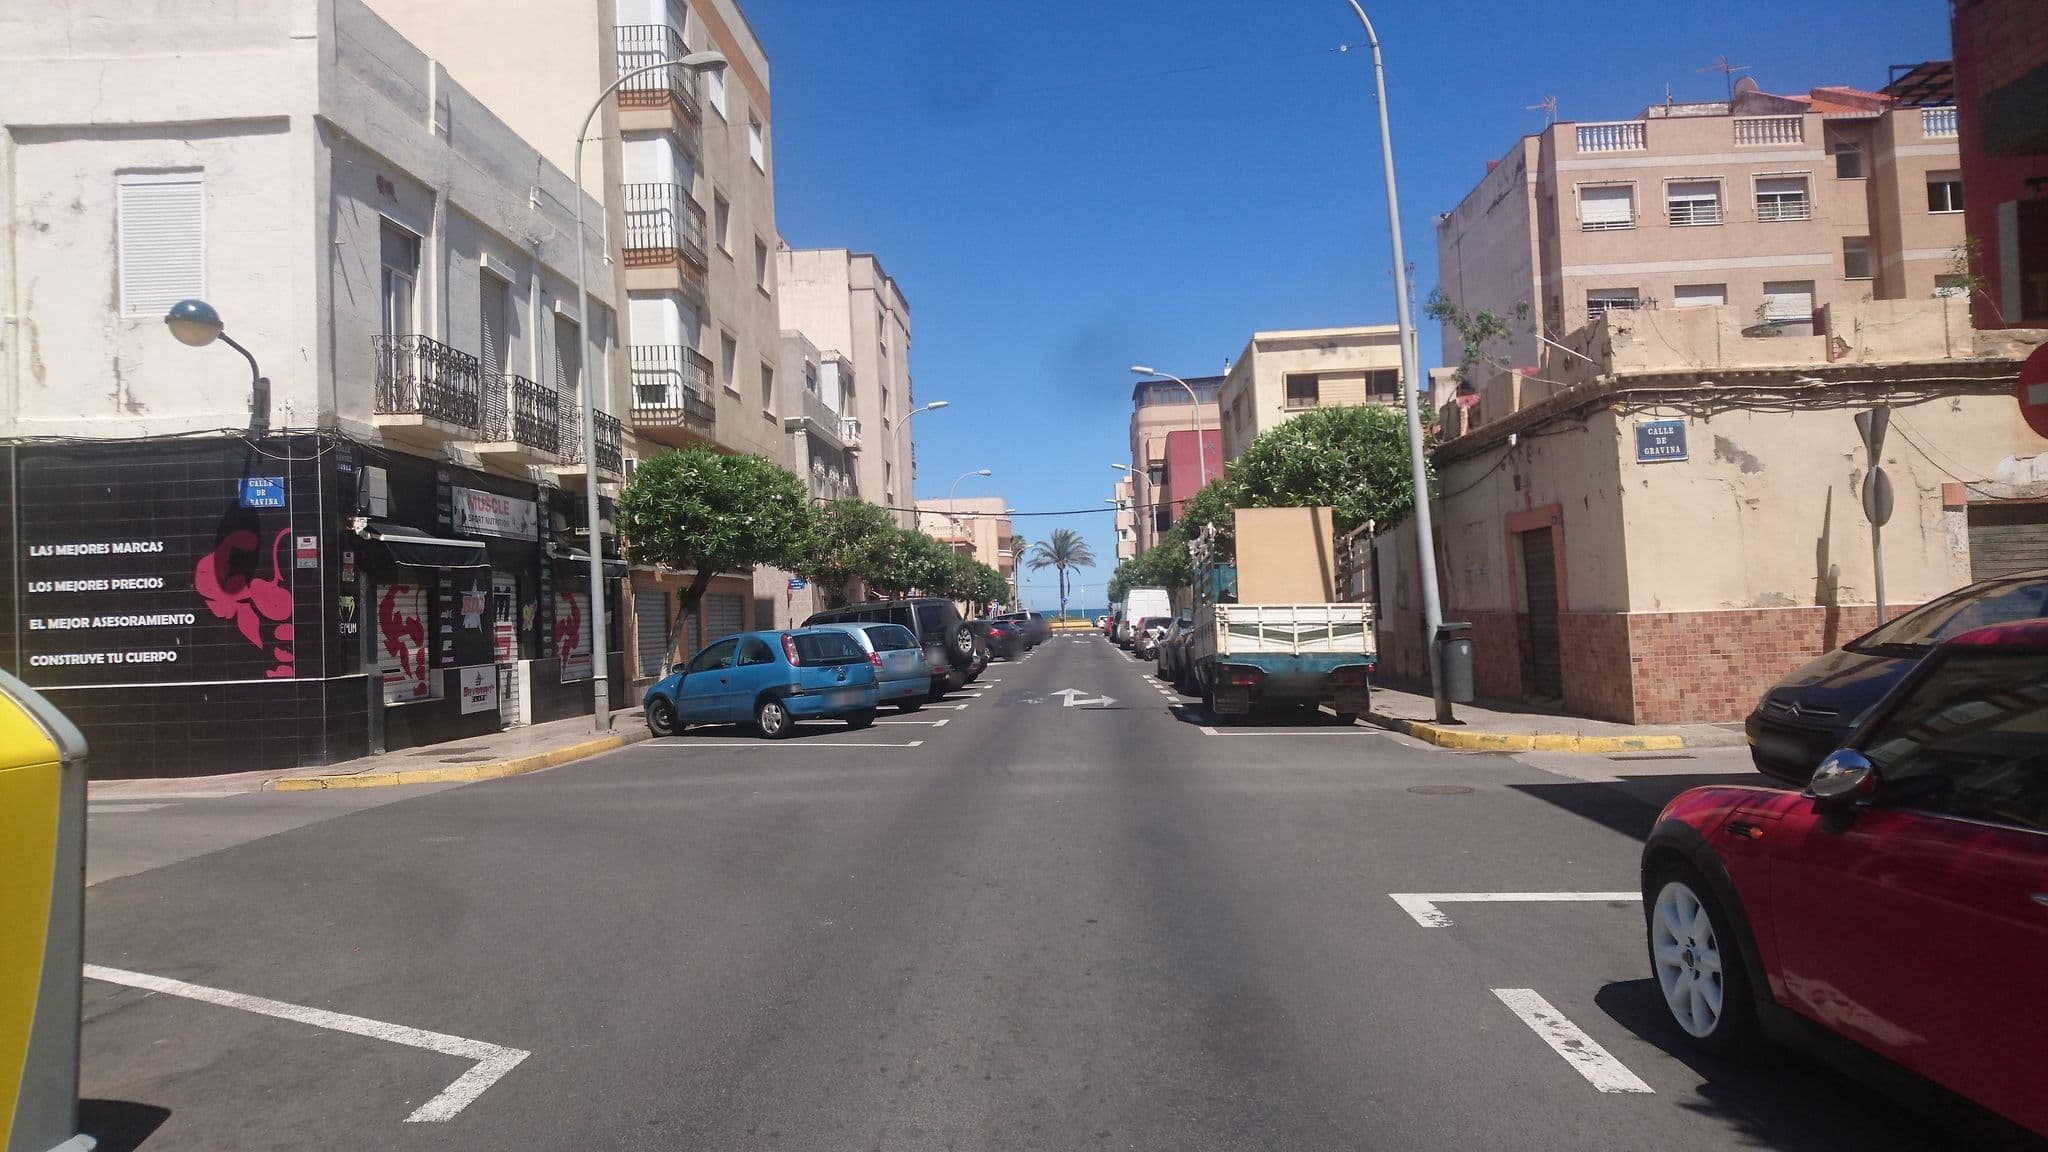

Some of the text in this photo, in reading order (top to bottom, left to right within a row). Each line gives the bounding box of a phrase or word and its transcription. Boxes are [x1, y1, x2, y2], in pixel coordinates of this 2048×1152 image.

[1647, 427, 1674, 435] CALLE
[1656, 437, 1667, 445] DE
[1644, 446, 1681, 455] GRAVINA
[249, 479, 274, 487] CALLE
[246, 498, 279, 506] RAVINA
[467, 495, 510, 515] MUSCLE
[30, 541, 164, 556] LAS MEJORES MARCAS
[28, 577, 164, 592] LOS MEJORES PRECIOS
[29, 613, 195, 630] EL MEJOR ASESORAMIENTO
[30, 651, 178, 667] CONSTRUYE TU CUERPO
